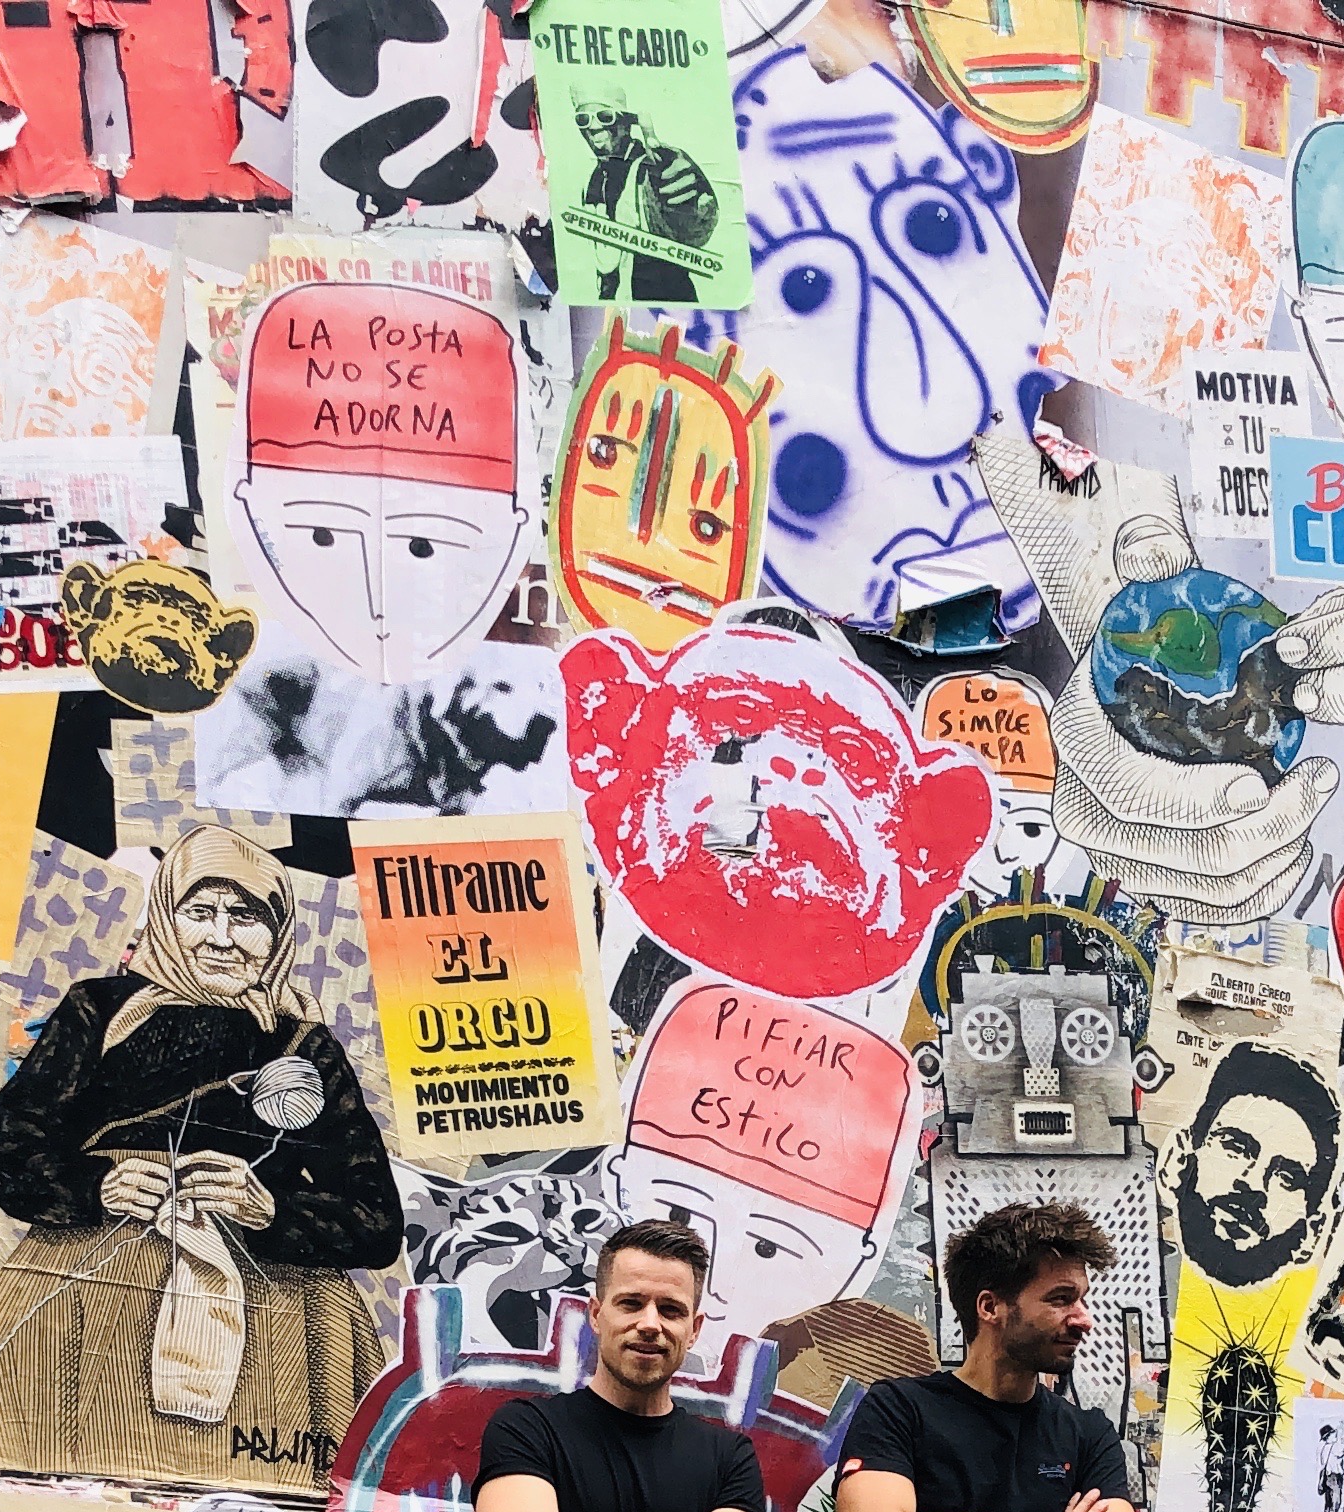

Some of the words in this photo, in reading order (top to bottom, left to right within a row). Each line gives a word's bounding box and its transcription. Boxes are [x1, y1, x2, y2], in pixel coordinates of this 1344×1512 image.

[618, 27, 690, 69] CABIO
[287, 317, 333, 351] LA
[305, 356, 363, 388] NO
[387, 358, 428, 389] SE
[1195, 370, 1299, 406] MOTIVA
[313, 401, 458, 441] ADORNA
[1239, 414, 1266, 454] TU
[371, 853, 550, 920] Filtrame
[425, 931, 509, 985] EL
[415, 1073, 570, 1107] MOVIMIENTO
[734, 1053, 807, 1093] CON
[416, 1100, 585, 1136] PETRUSHAUS
